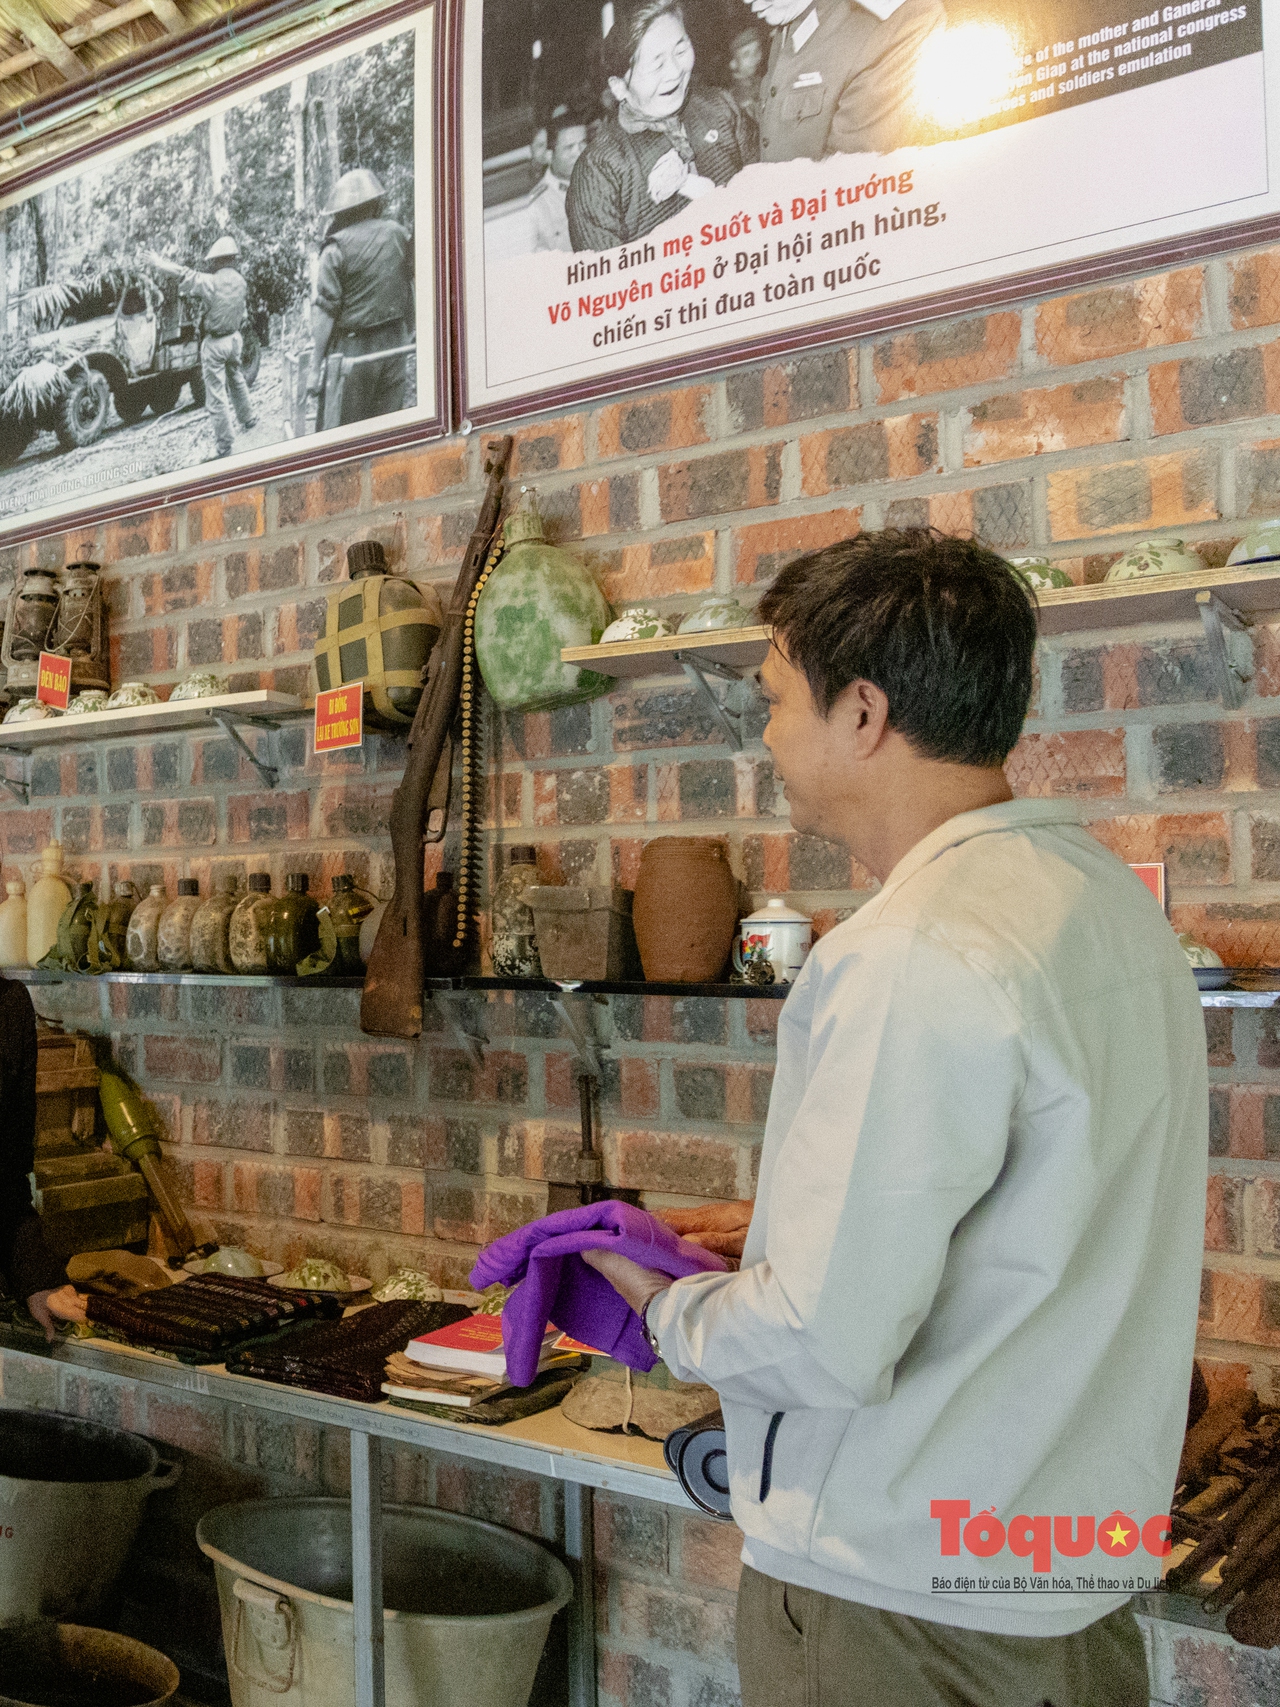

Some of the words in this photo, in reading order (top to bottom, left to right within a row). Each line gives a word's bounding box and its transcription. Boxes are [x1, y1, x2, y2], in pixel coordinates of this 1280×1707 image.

[1029, 83, 1055, 103] and
[1058, 66, 1115, 95] soldiers
[1118, 43, 1192, 77] emulation
[1035, 45, 1050, 63] of
[1052, 40, 1075, 58] the
[1078, 22, 1129, 50] mother
[1132, 10, 1159, 33] and
[1036, 61, 1067, 82] Giap
[1070, 54, 1085, 72] at
[1087, 48, 1110, 66] the
[1113, 26, 1173, 58] national
[1176, 5, 1247, 39] congress
[548, 301, 572, 325] Võ
[578, 279, 653, 318] Nguyên
[660, 264, 706, 294] Giáp
[713, 255, 729, 280] ở
[734, 243, 769, 275] Đại
[777, 231, 812, 264] hội
[820, 220, 865, 251] anh
[874, 201, 947, 237] hùng,
[567, 255, 611, 286] Hình
[618, 243, 656, 270] ảnh
[663, 235, 694, 258] mẹ
[700, 210, 752, 246] Suốt
[758, 202, 784, 230] và
[791, 189, 827, 221] Đại
[835, 169, 915, 208] tướng
[593, 314, 647, 348] chiến
[654, 308, 673, 332] sĩ
[678, 298, 707, 325] thi
[715, 293, 756, 316] đua
[763, 273, 815, 303] toàn
[823, 252, 881, 292] quốc
